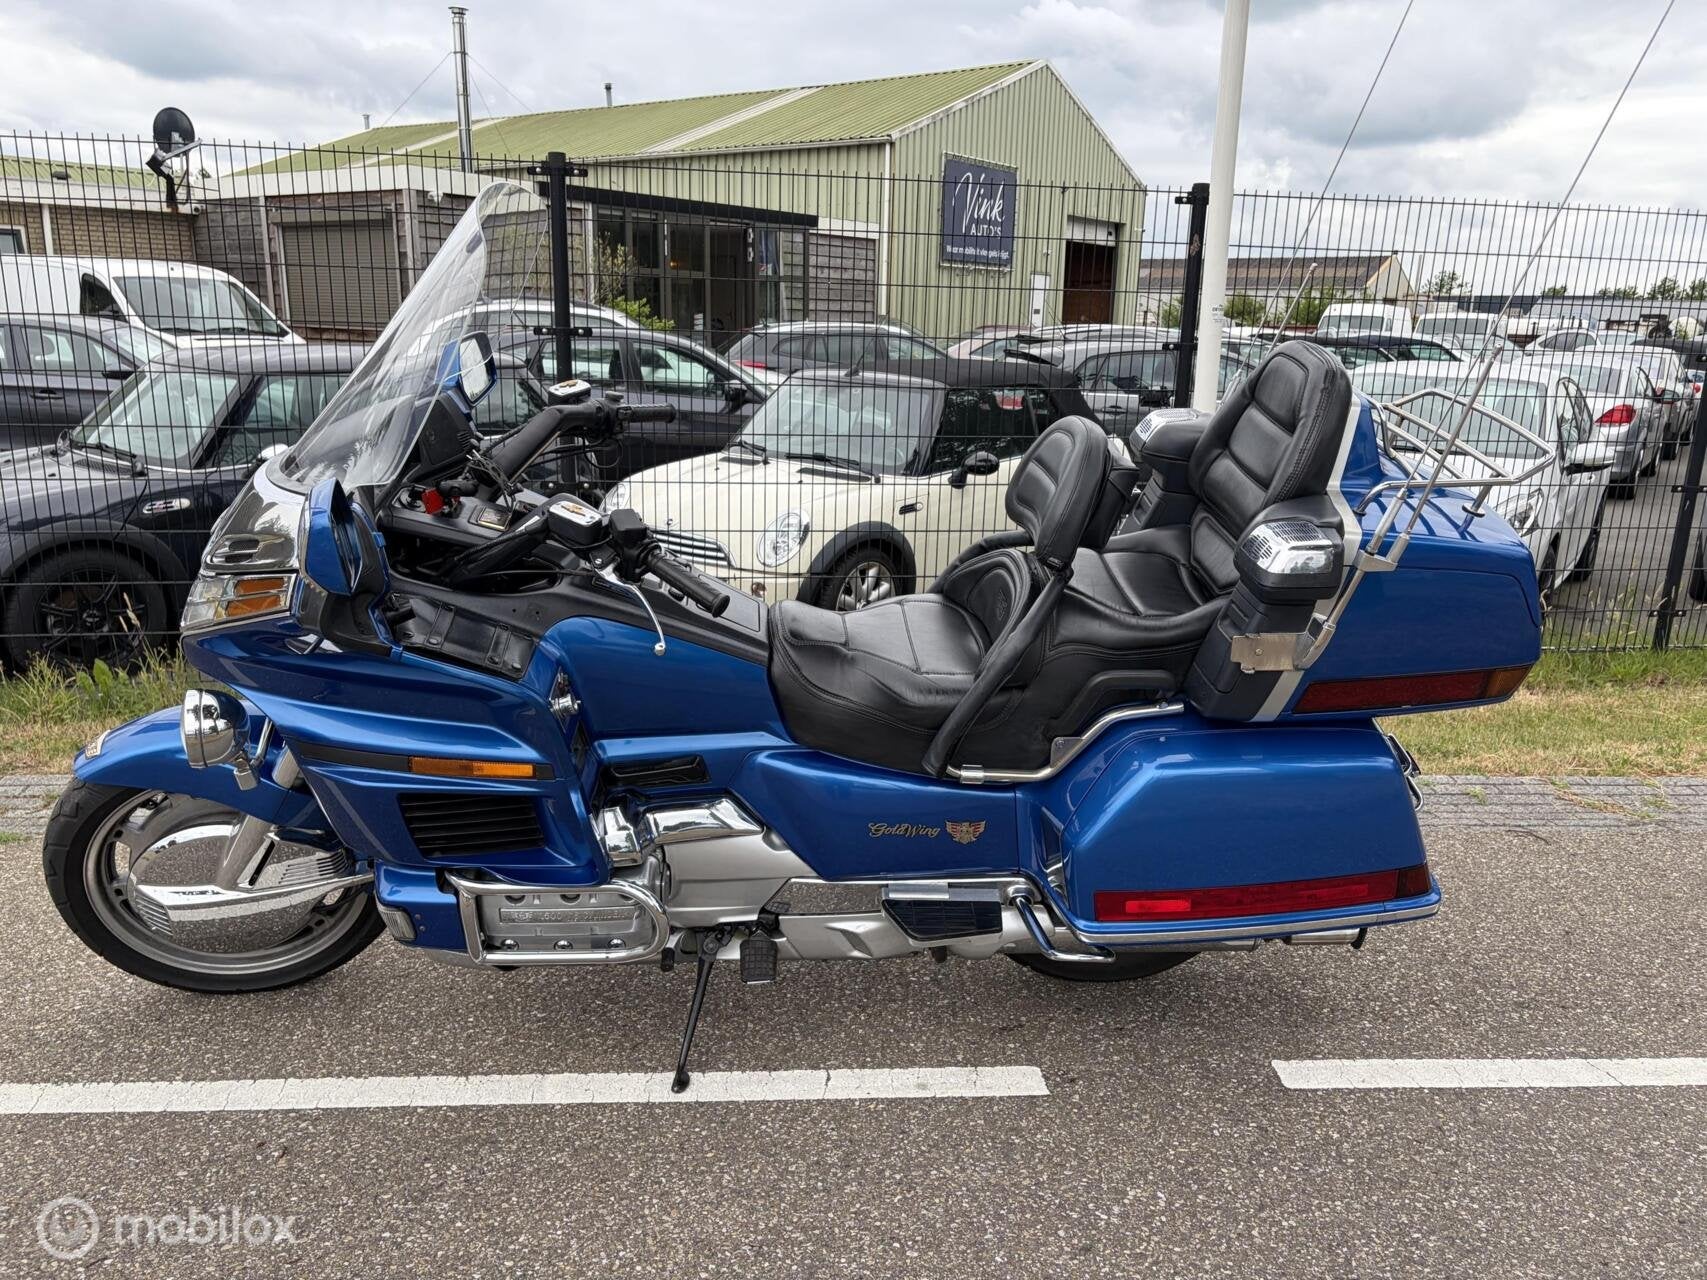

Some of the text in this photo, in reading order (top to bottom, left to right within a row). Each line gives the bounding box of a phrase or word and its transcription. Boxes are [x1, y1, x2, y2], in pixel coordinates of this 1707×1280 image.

[952, 172, 1005, 234] Vink
[970, 223, 1002, 239] AUTO'S
[980, 248, 997, 258] vlegels
[868, 822, 941, 838] GoldWing
